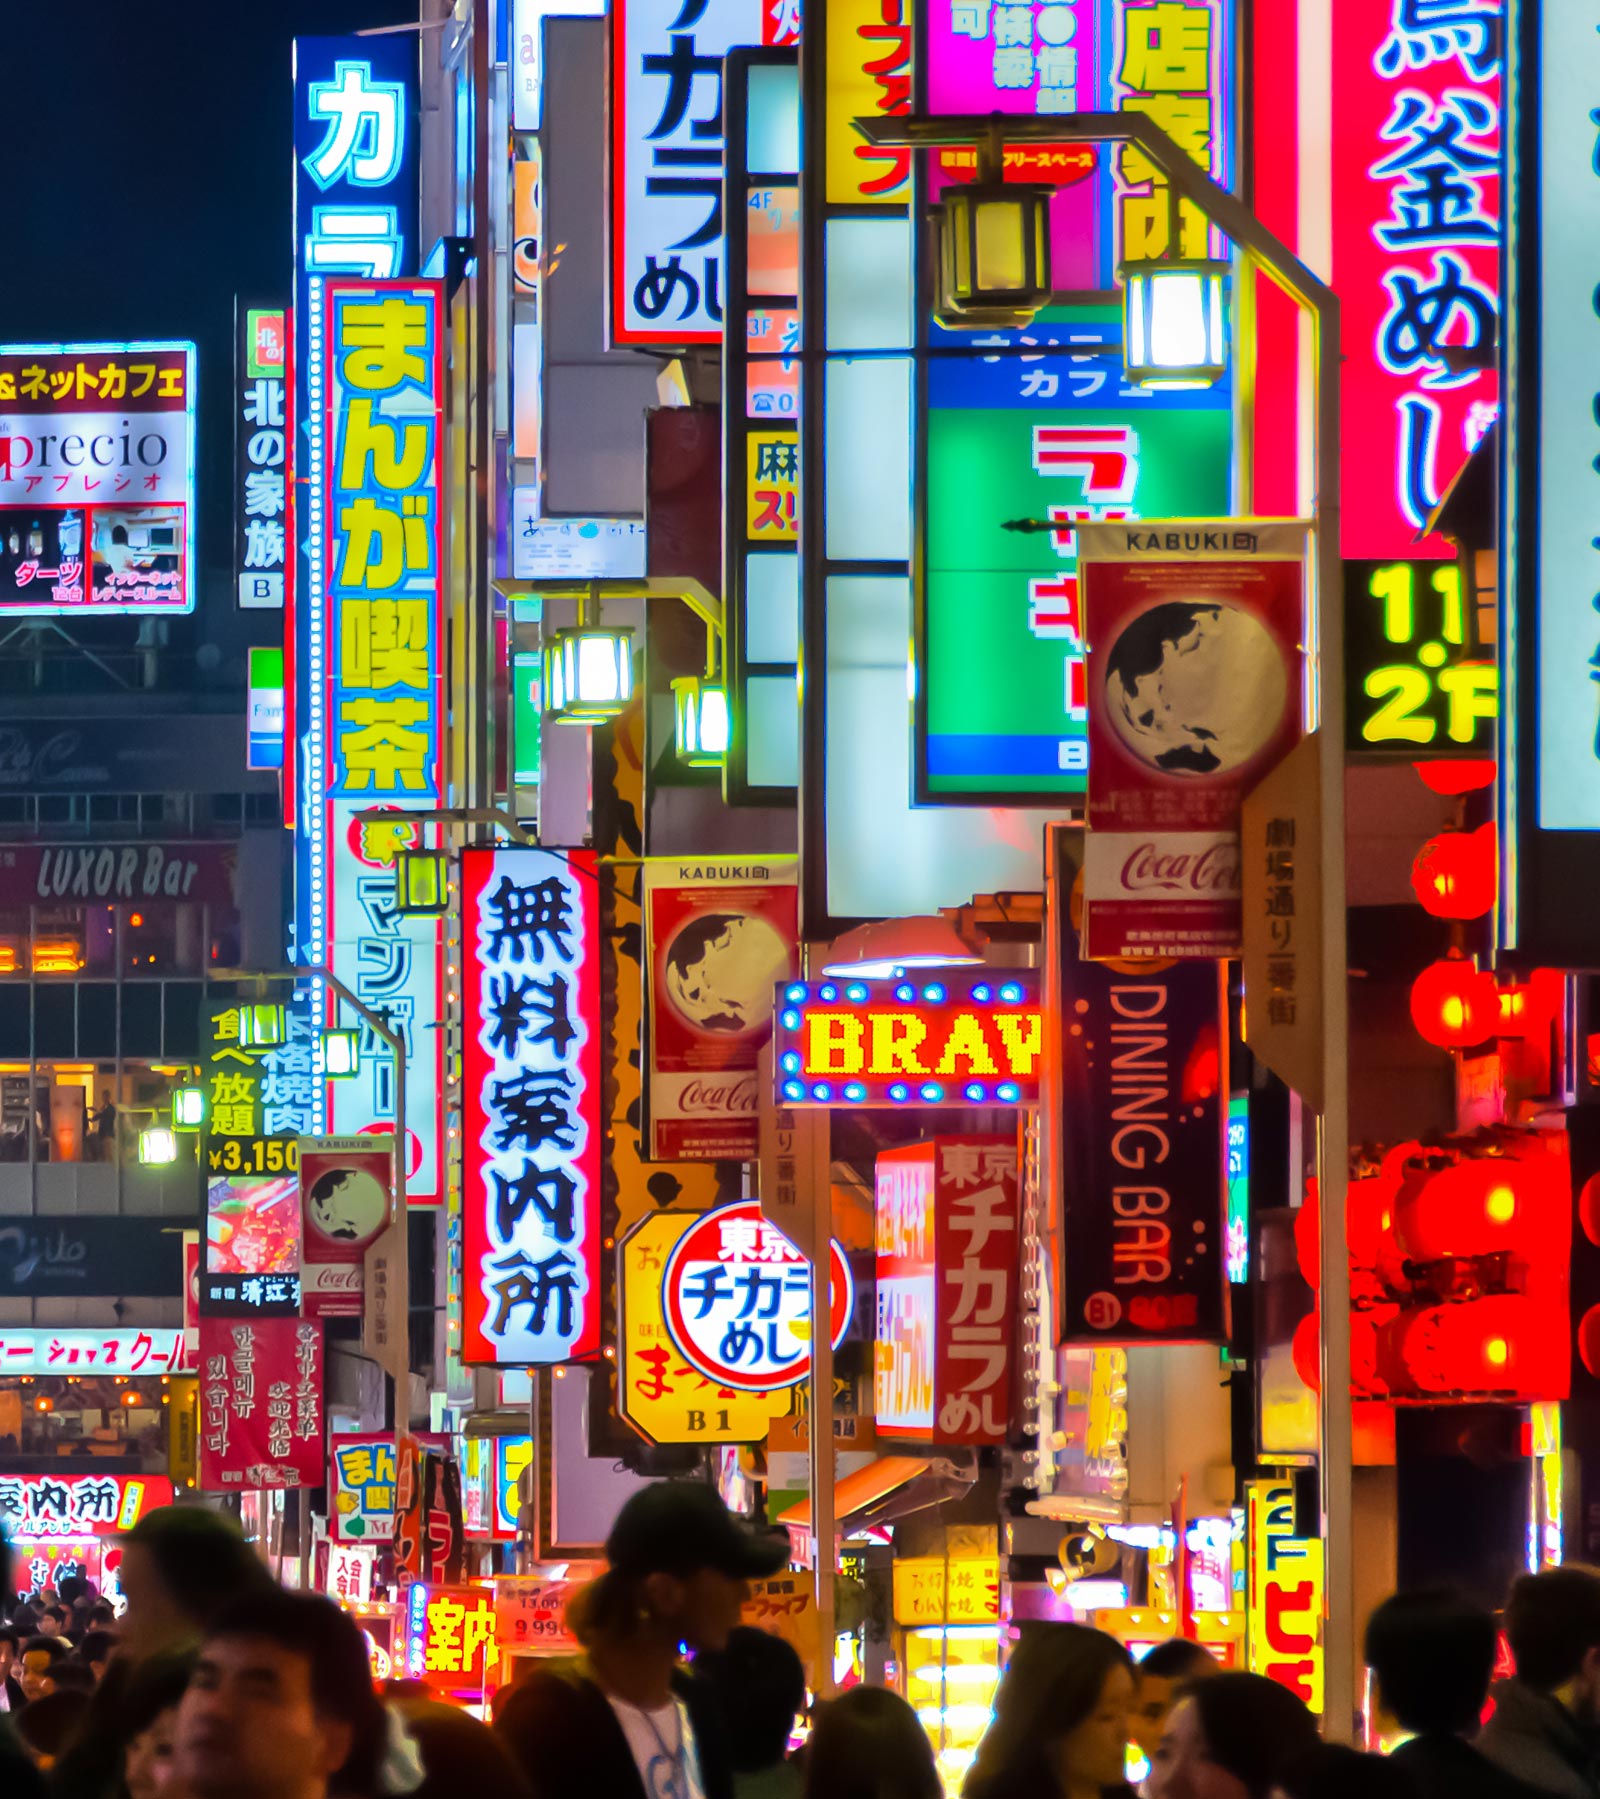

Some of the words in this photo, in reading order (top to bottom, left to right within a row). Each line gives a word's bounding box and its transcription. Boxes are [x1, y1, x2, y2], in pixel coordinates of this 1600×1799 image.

[748, 192, 774, 210] 4F
[748, 319, 774, 336] 3F
[24, 472, 162, 493] アプレシオ
[243, 379, 284, 568] 北の家族
[14, 561, 83, 587] ダーツ
[341, 299, 429, 790] まんが喫茶
[1361, 664, 1499, 744] 2F
[37, 846, 139, 898] LUXOR
[143, 846, 199, 896] Bar
[1264, 818, 1297, 1026] 劇場通り一番街
[485, 875, 581, 1338] 無料案内所
[1109, 984, 1171, 1171] DINING
[938, 1142, 1017, 1190] 東京
[1111, 1186, 1172, 1285] BAR
[945, 1183, 1016, 1392] チカラ
[230, 1324, 256, 1420] 한글메뉴
[719, 1320, 803, 1366] めし
[204, 1353, 231, 1458] 있습니다
[938, 1393, 1009, 1436] めし
[425, 1596, 499, 1672] 案内
